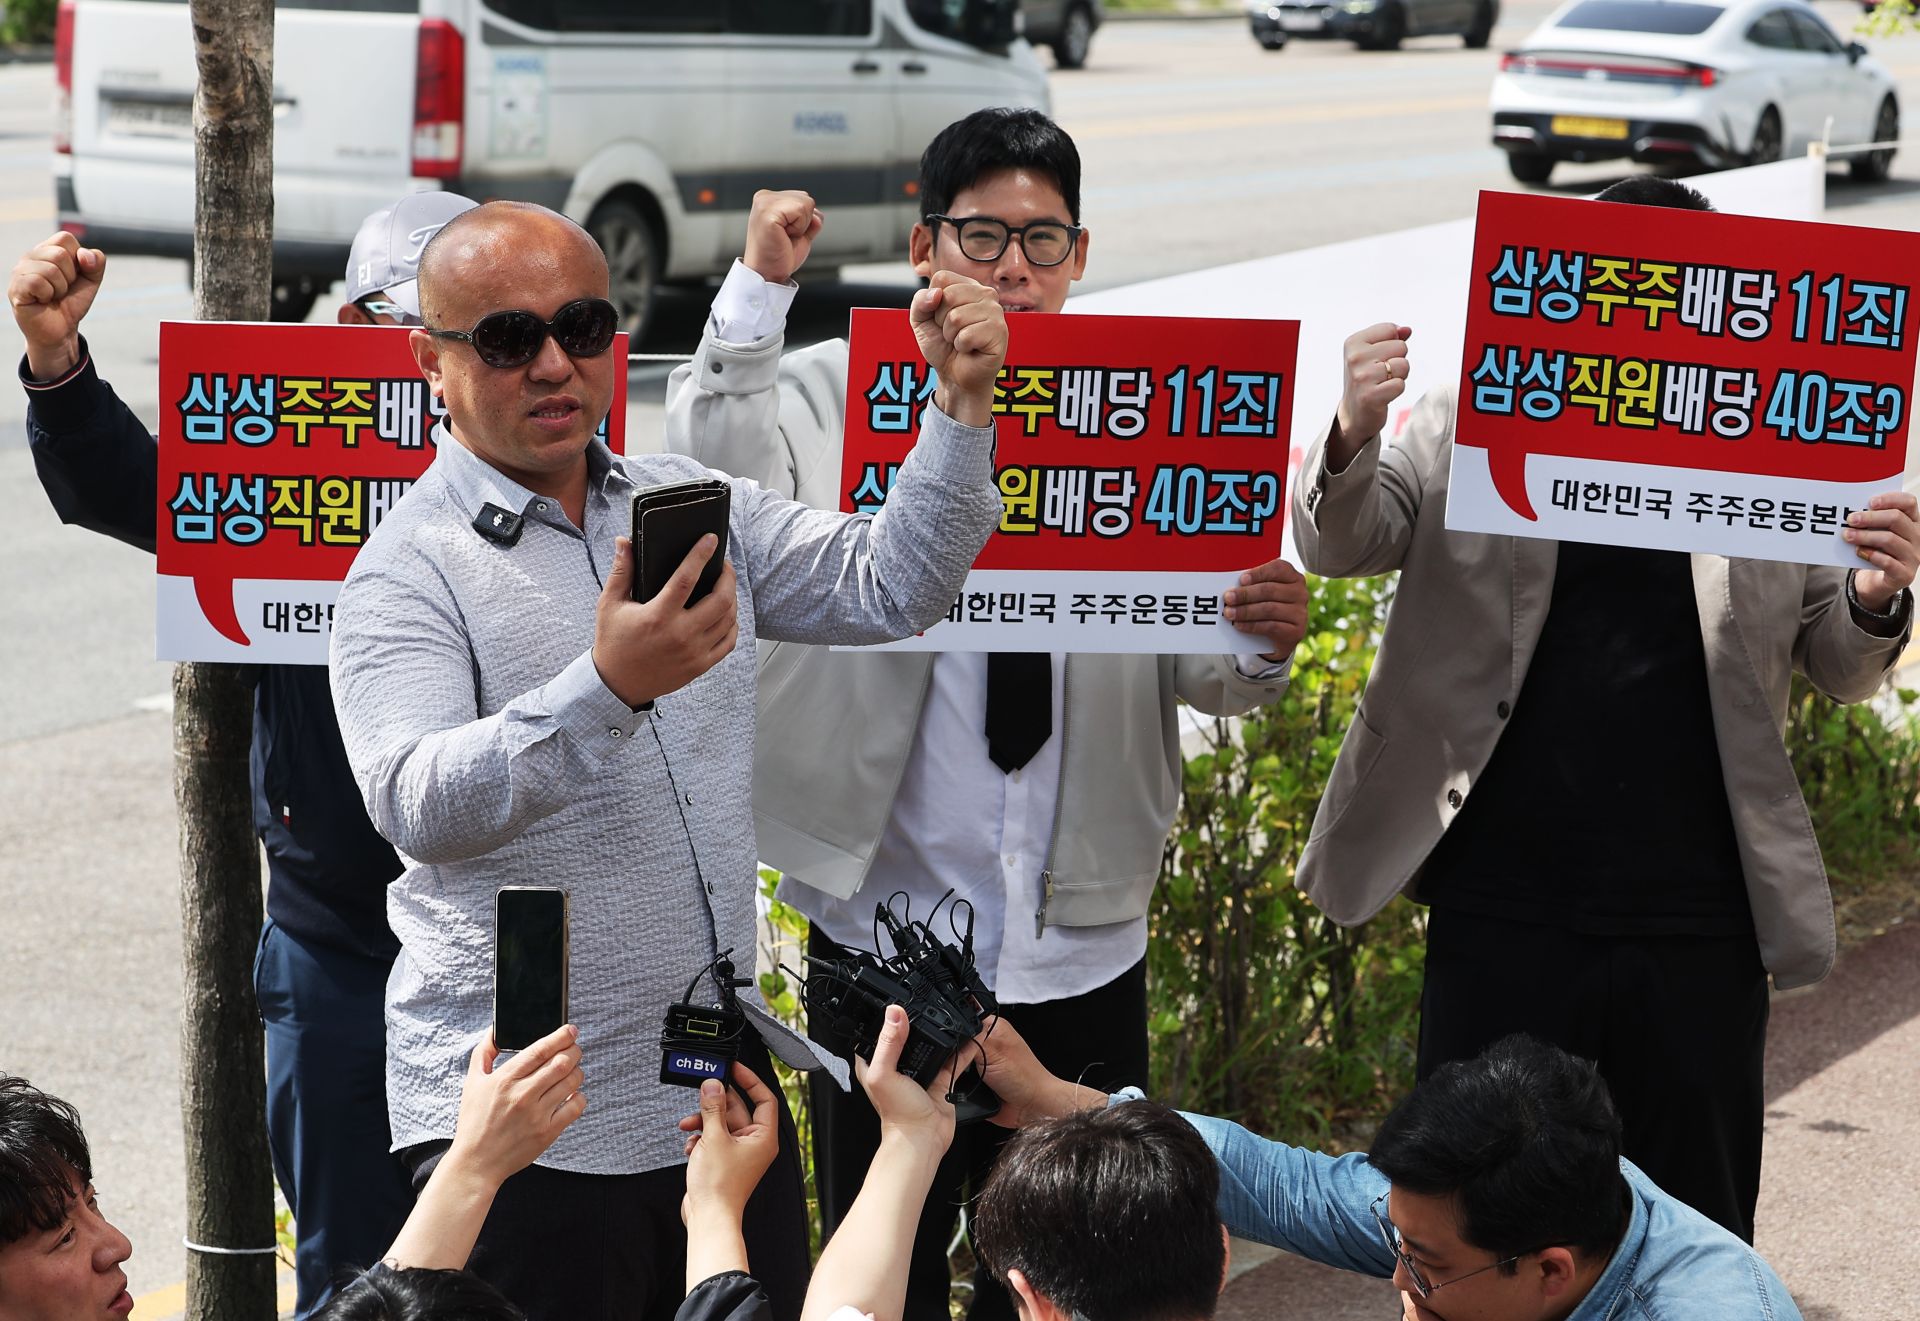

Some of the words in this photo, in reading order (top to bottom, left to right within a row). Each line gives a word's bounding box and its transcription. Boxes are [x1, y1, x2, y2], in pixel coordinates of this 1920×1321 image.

[1491, 249, 1776, 339] 삼성주주배당
[1792, 275, 1905, 347] 11조!
[1167, 368, 1278, 435] 11조!
[1473, 348, 1757, 437] 삼성직원배당
[1765, 372, 1901, 445] 40조?
[1145, 467, 1278, 533] 40조?
[1551, 478, 1673, 519] 대한민국
[263, 602, 335, 633] 대한
[1069, 594, 1235, 627] 주주운동본
